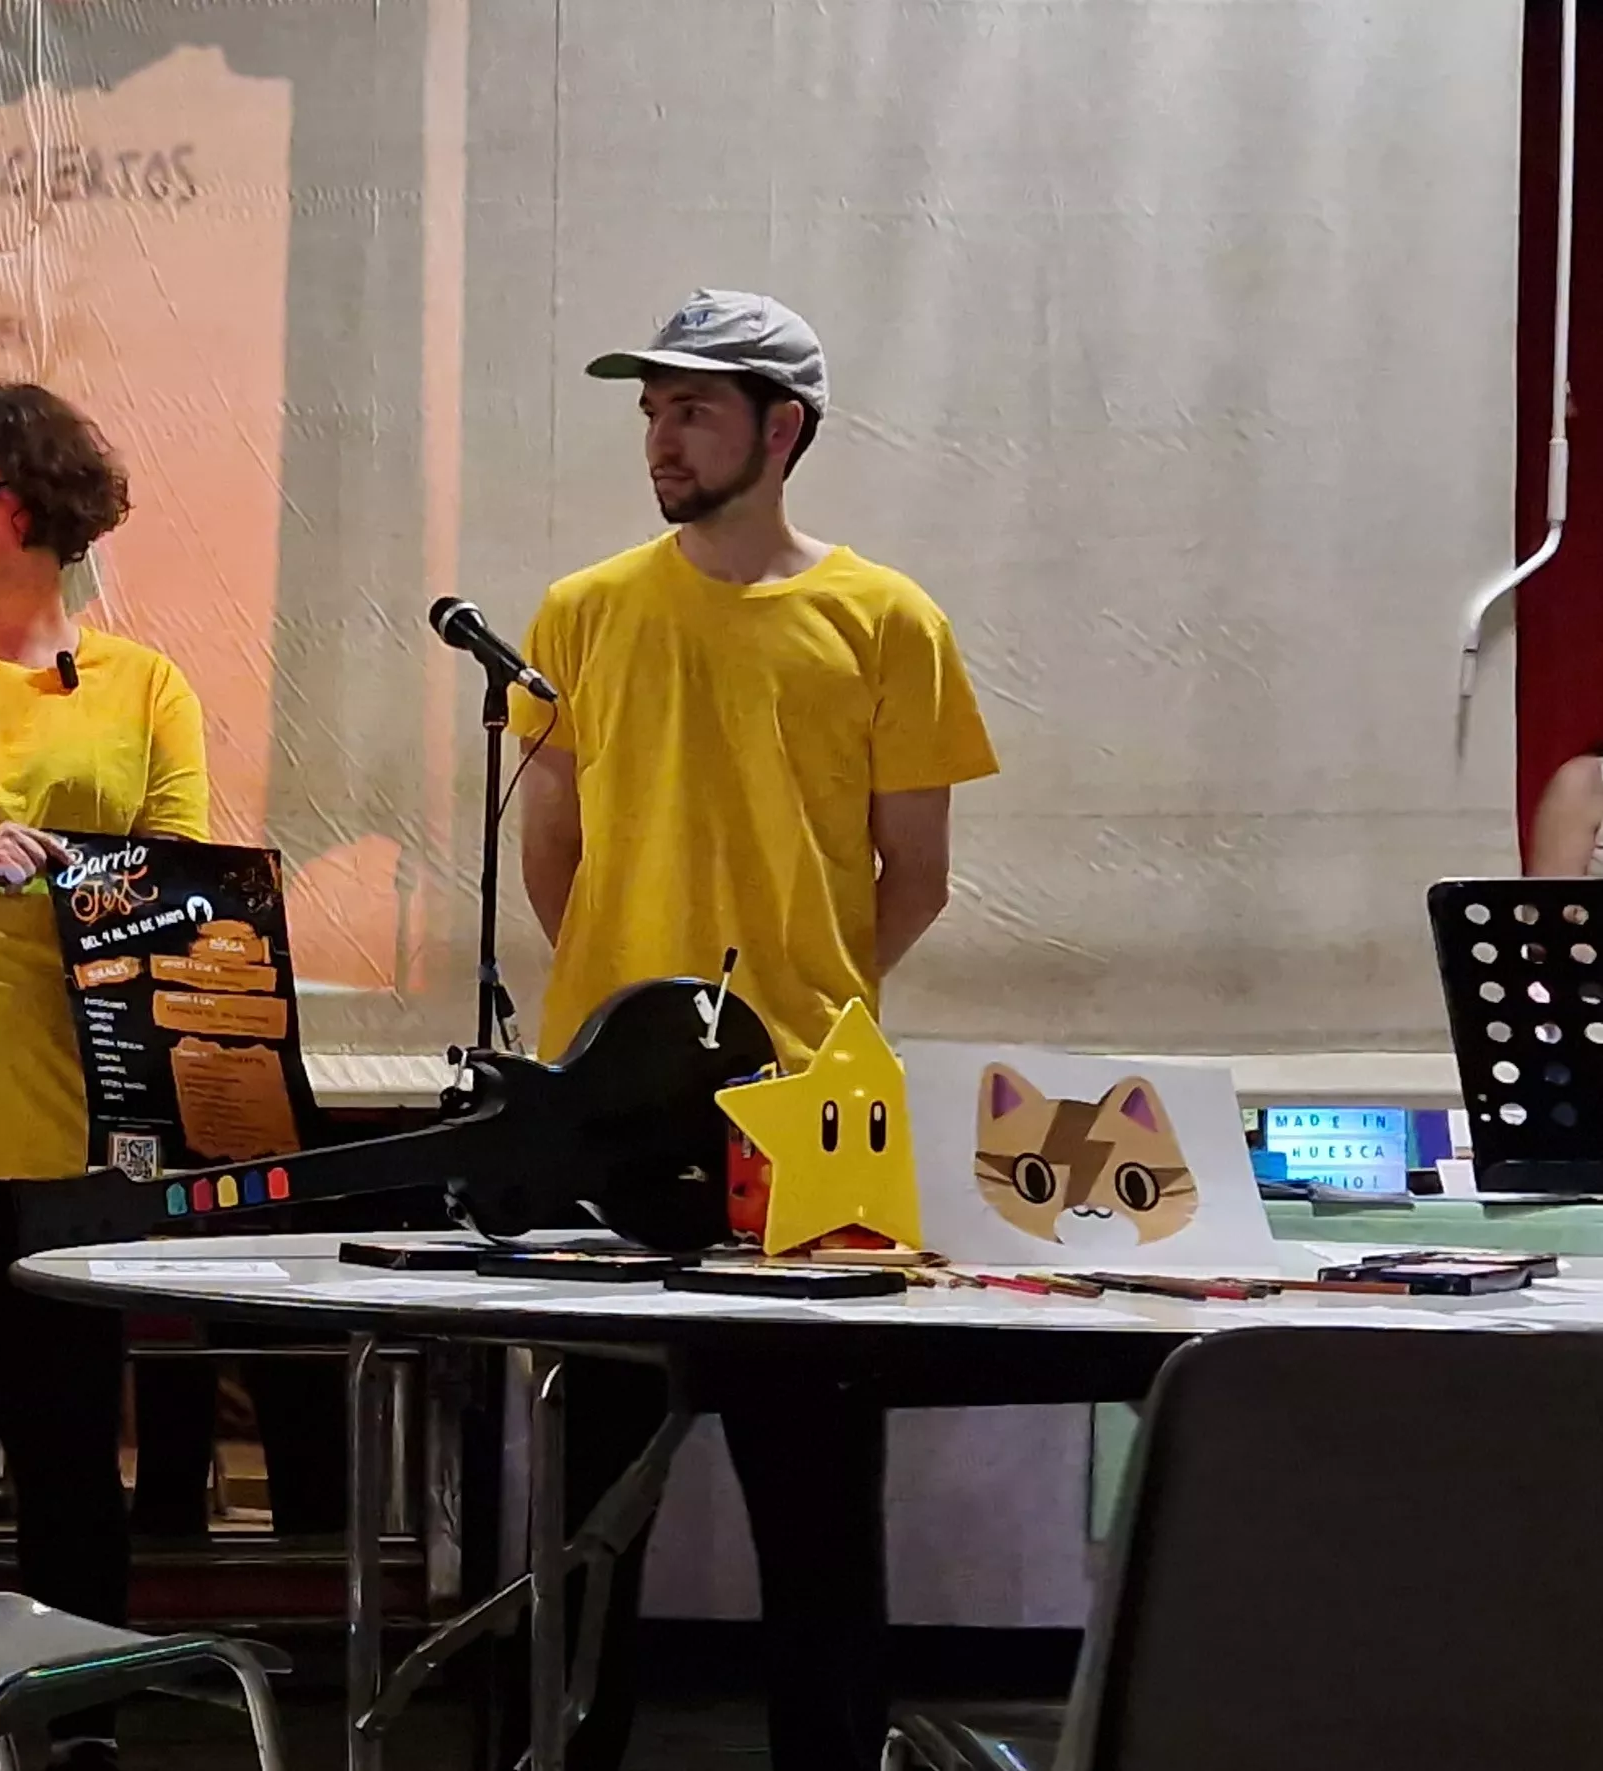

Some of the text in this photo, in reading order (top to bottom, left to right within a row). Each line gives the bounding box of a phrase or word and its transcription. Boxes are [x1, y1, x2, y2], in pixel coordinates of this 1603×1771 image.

[57, 838, 149, 889] Barrio
[80, 934, 103, 952] DEL
[1275, 1113, 1341, 1129] MADE
[1362, 1114, 1387, 1129] IN
[1291, 1145, 1386, 1160] HUESCA
